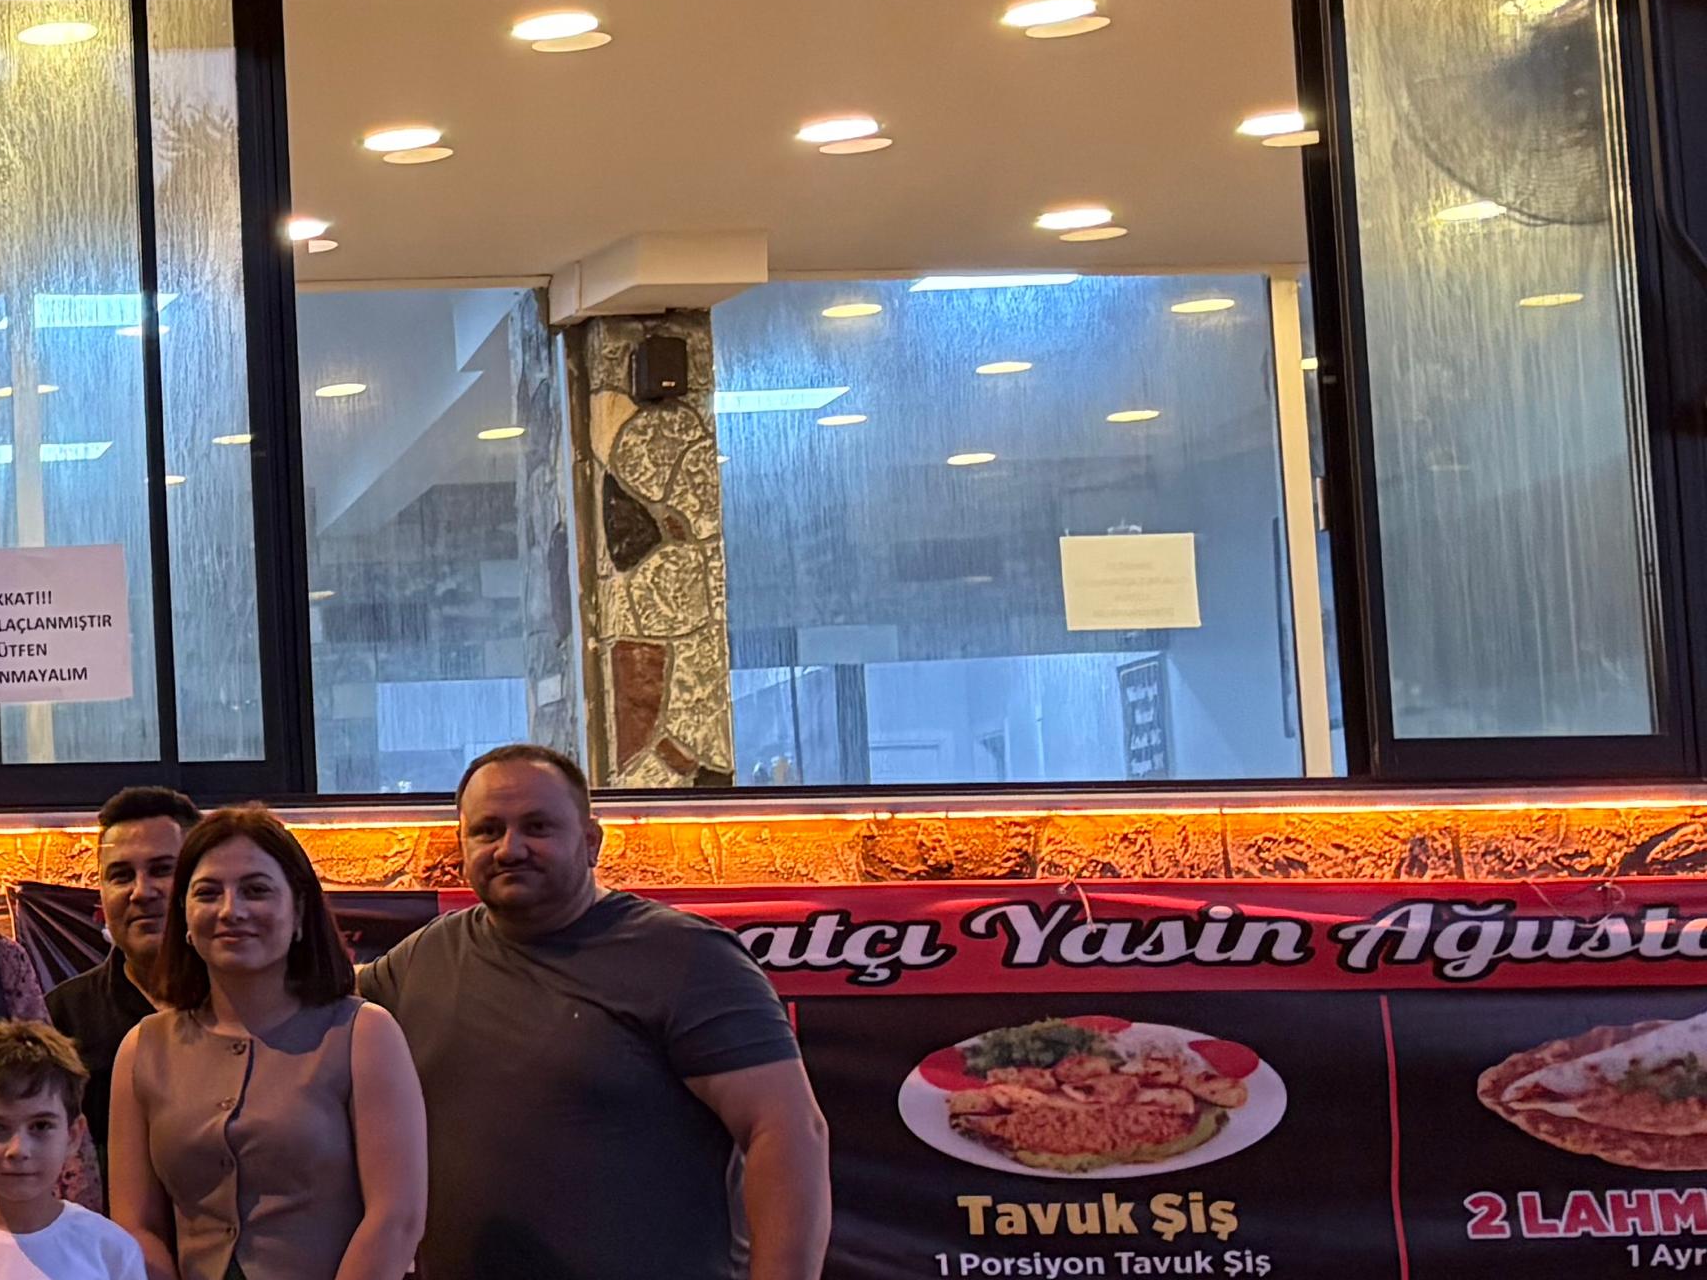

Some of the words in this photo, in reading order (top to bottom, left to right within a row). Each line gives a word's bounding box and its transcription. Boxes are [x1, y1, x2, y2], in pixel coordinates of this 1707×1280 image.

[740, 909, 953, 983] atçı
[961, 901, 1312, 966] Yasin
[957, 1193, 1138, 1235] Tavuk
[1149, 1192, 1238, 1241] Şiş
[1463, 1192, 1511, 1240] 2
[935, 1253, 949, 1276] 1
[959, 1252, 1105, 1280] Porsiyon
[1114, 1251, 1214, 1275] Tavuk
[1223, 1249, 1271, 1277] Şiş
[1627, 1244, 1640, 1267] 1
